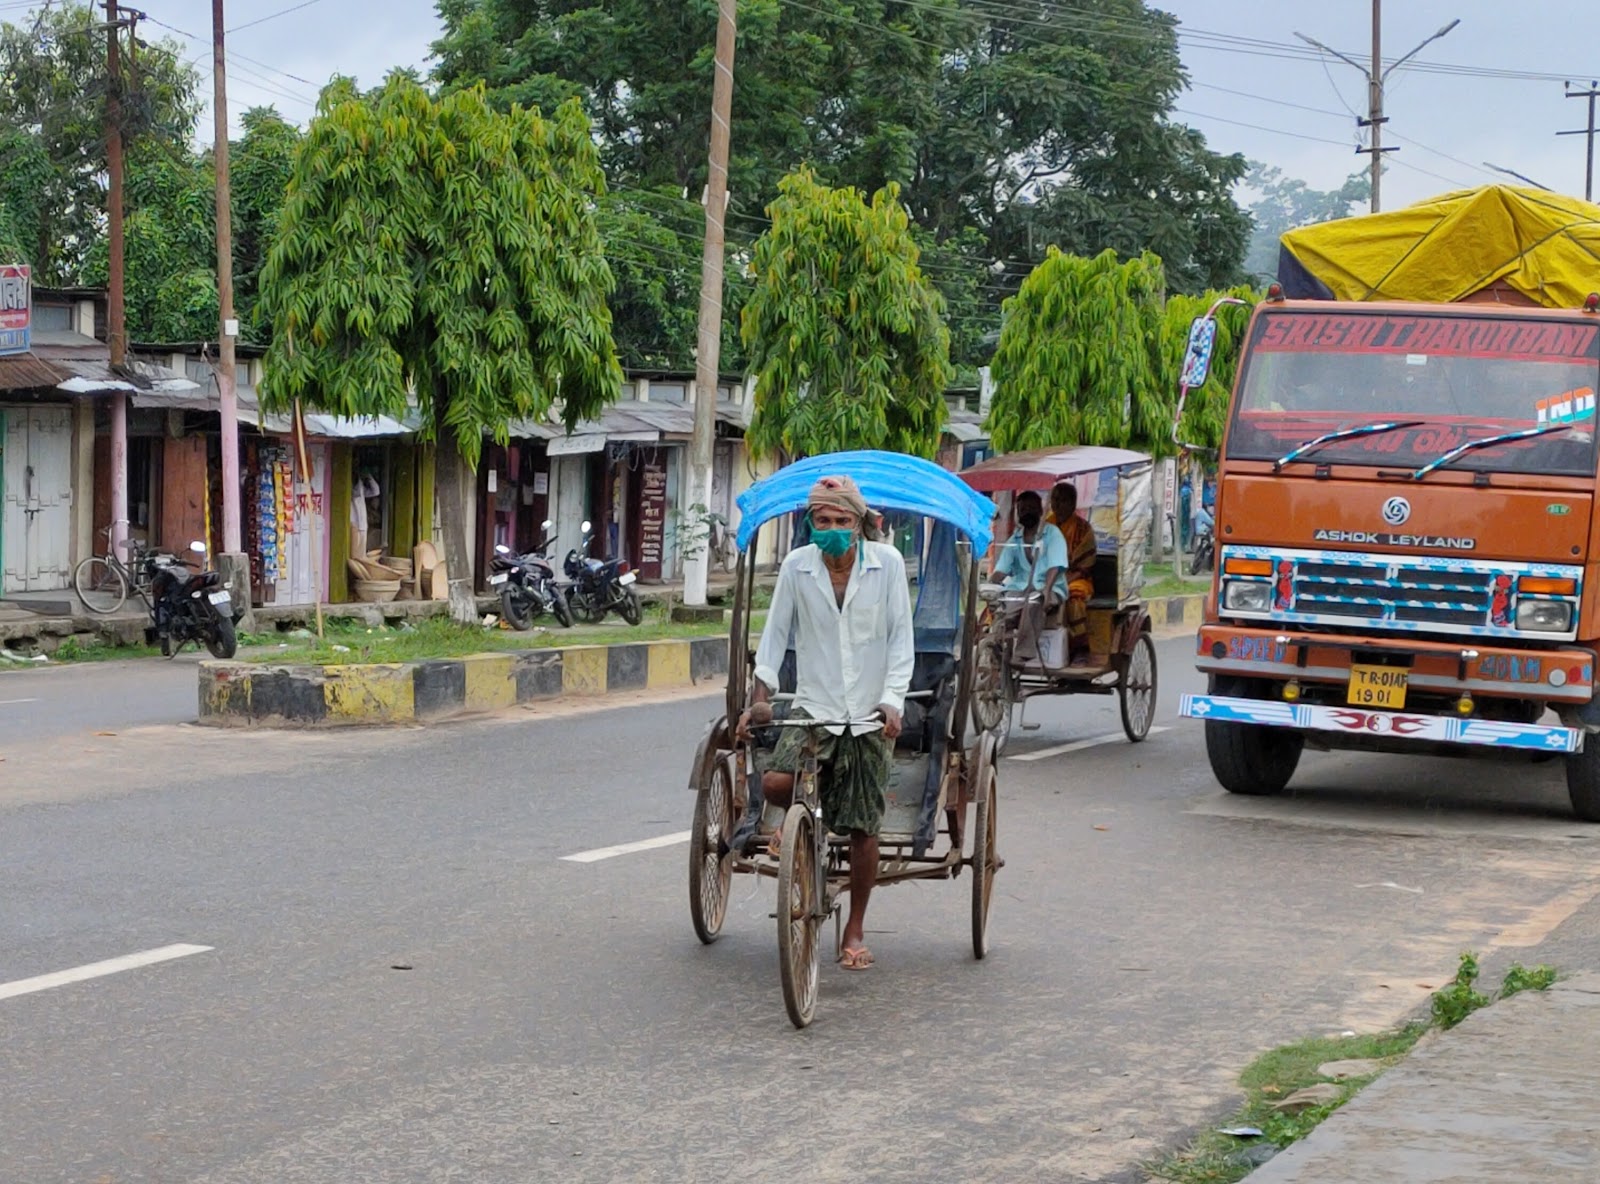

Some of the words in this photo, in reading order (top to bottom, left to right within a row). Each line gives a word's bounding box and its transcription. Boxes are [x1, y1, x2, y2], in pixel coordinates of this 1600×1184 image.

[1315, 529, 1378, 544] ASHOK
[1389, 534, 1475, 549] LEYLAND
[1230, 634, 1287, 662] SPEED
